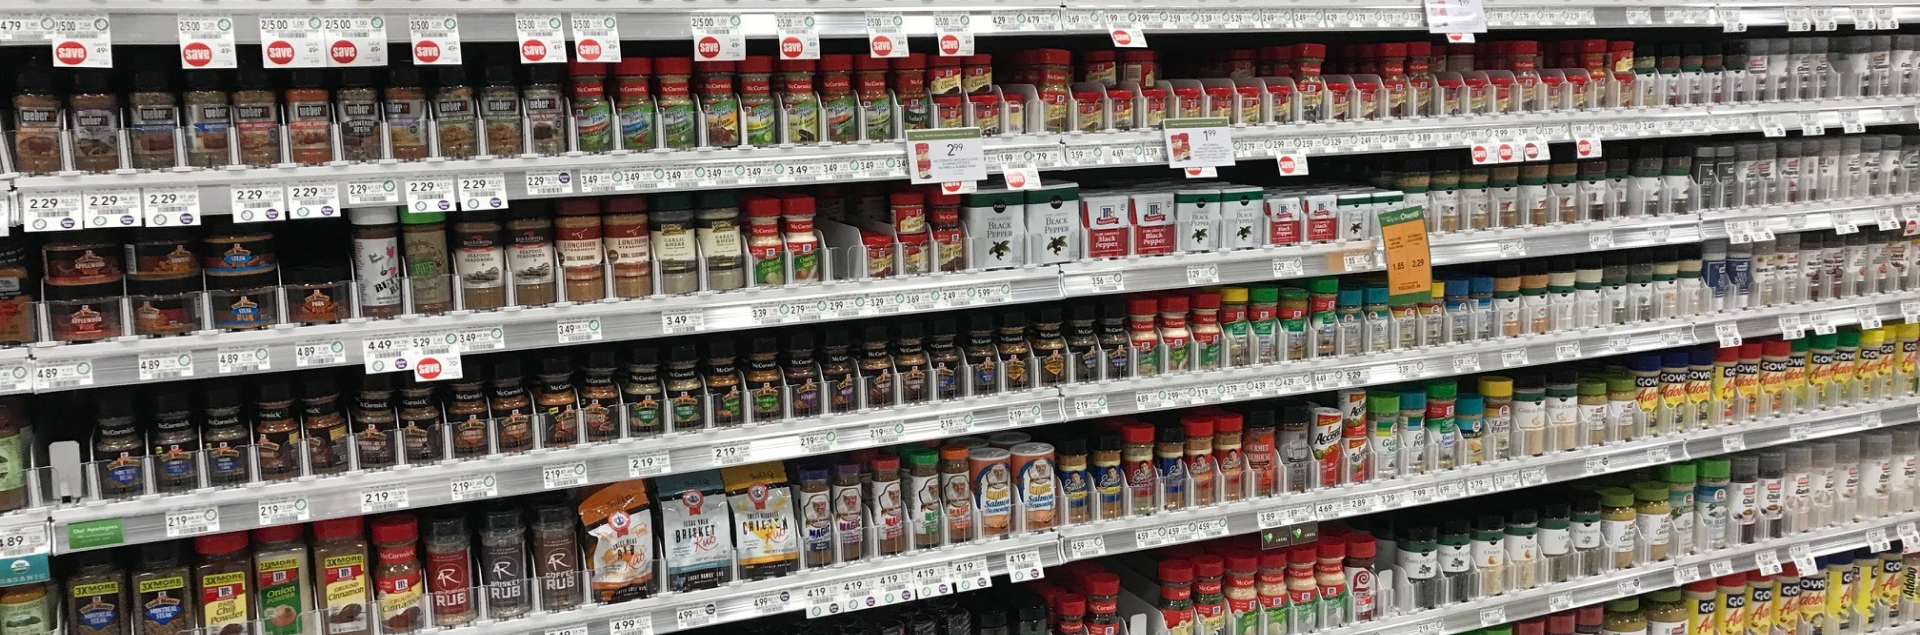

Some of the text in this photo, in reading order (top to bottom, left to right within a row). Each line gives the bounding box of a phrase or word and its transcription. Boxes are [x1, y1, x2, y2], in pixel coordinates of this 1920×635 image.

[699, 42, 719, 53] save
[782, 41, 802, 52] save
[873, 40, 892, 50] save
[941, 39, 959, 49] save
[58, 47, 84, 59] save
[185, 48, 210, 60] save
[269, 47, 292, 58] save
[333, 47, 355, 57] save
[416, 47, 438, 57] save
[522, 46, 545, 56] save
[578, 45, 602, 55] save
[347, 104, 370, 114] weber
[441, 101, 463, 111] weber
[490, 100, 512, 110] weber
[530, 99, 552, 109] weber
[23, 110, 49, 120] weber
[142, 109, 167, 119] weber
[205, 109, 227, 118] weber
[240, 107, 263, 117] weber
[300, 106, 322, 116] weber
[81, 116, 103, 125] weber
[988, 222, 1012, 230] BLACK
[1044, 226, 1070, 234] PEPPER
[419, 364, 440, 375] save
[676, 525, 715, 543] BRISKET
[809, 525, 829, 538] MAGIC
[153, 578, 182, 587] MORE
[216, 574, 243, 582] MORE
[546, 576, 575, 590] RUB
[88, 583, 117, 591] MORE
[267, 586, 295, 598] Onion
[334, 582, 359, 592] GROUND
[328, 587, 364, 600] Cinnamon
[491, 586, 520, 599] RUB
[436, 594, 466, 606] RUB
[216, 606, 236, 615] Chili
[211, 611, 244, 624] Powder
